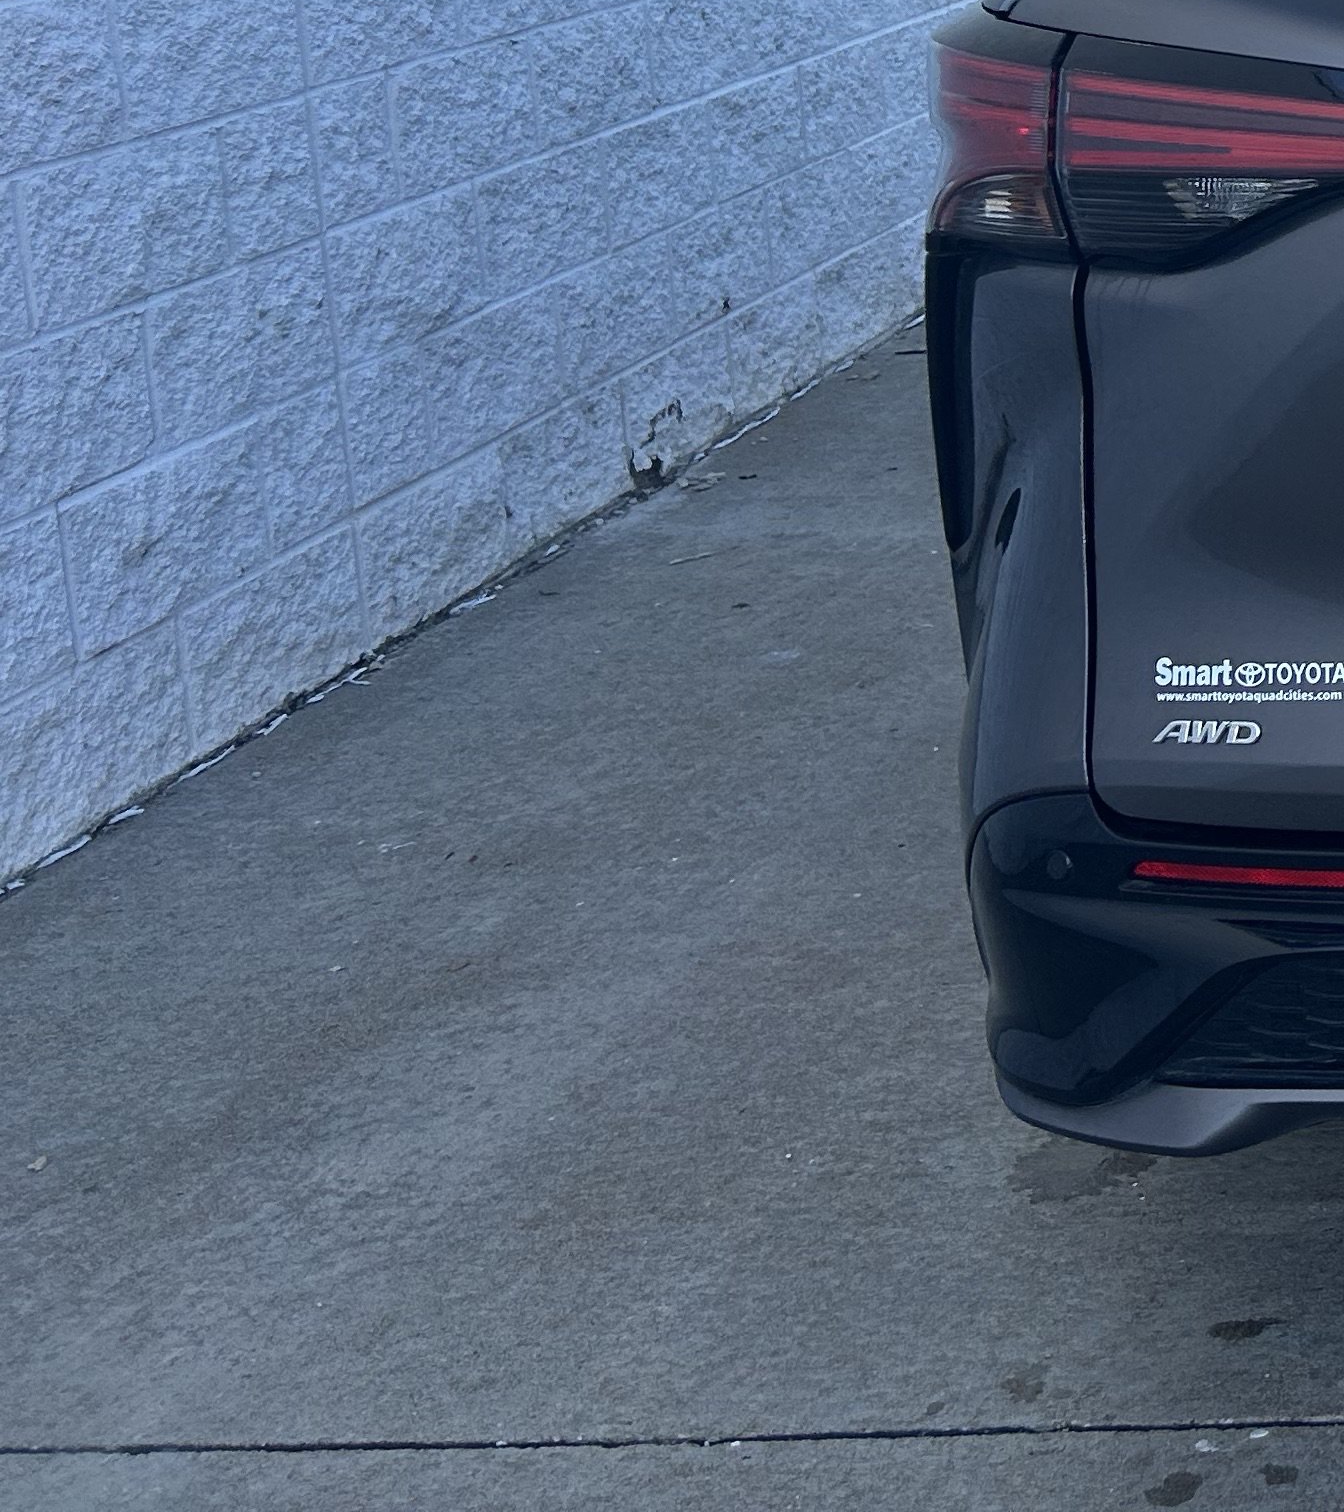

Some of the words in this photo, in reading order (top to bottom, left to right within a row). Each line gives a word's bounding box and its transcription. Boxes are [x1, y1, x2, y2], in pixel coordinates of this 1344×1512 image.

[1154, 656, 1233, 686] Smart
[1156, 689, 1343, 704] www.smarttoyotaquadcities.com
[1152, 719, 1262, 745] AWD
